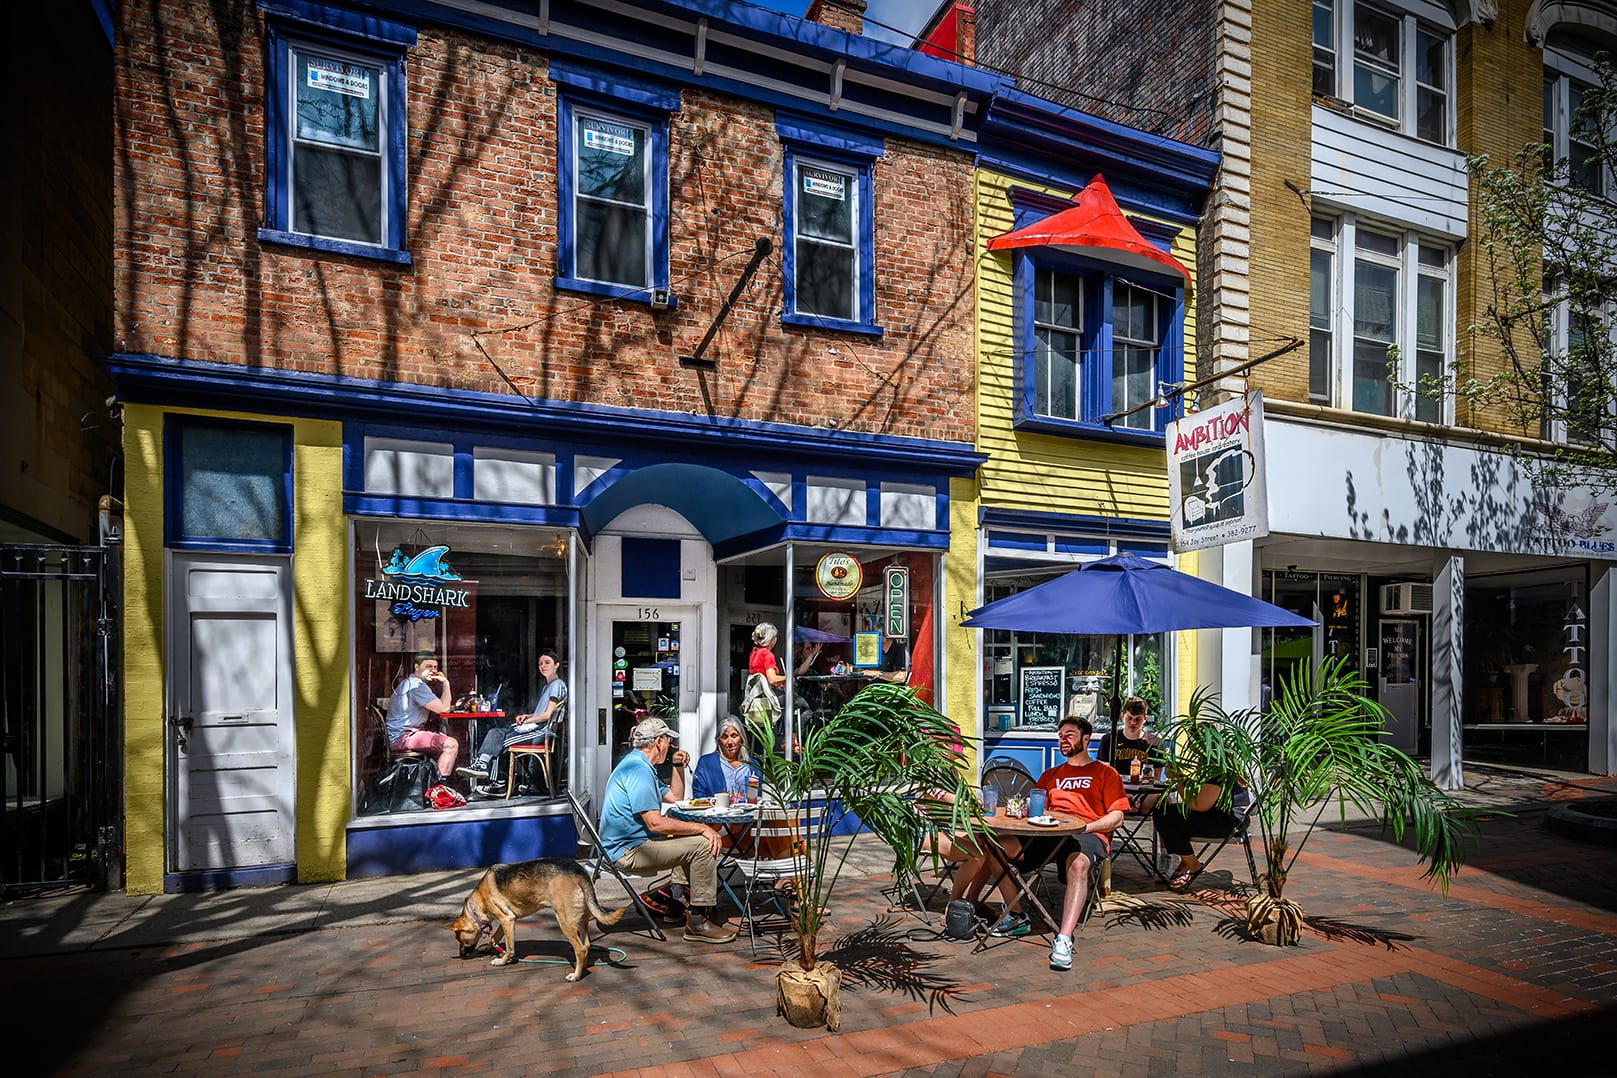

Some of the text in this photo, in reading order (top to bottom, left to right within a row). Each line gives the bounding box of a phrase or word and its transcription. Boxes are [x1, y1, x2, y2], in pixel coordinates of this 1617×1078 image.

[319, 74, 345, 84] WINDOWS
[351, 80, 368, 90] DOORS
[586, 121, 627, 137] SURVIVOR
[805, 170, 839, 184] SURVIVOR
[1174, 407, 1250, 455] AMBITION
[1181, 451, 1196, 461] coffee
[1197, 447, 1211, 457] house
[1201, 534, 1219, 544] Street
[1227, 525, 1257, 538] 382-9277
[1579, 539, 1615, 552] BLUES
[365, 579, 471, 608] LANDSHARK
[889, 572, 904, 634] OPEN
[393, 602, 441, 621] Lager
[638, 608, 660, 620] 156
[1383, 637, 1413, 645] WELCOME
[1562, 580, 1586, 708] TATTOO
[1056, 776, 1093, 790] VANS
